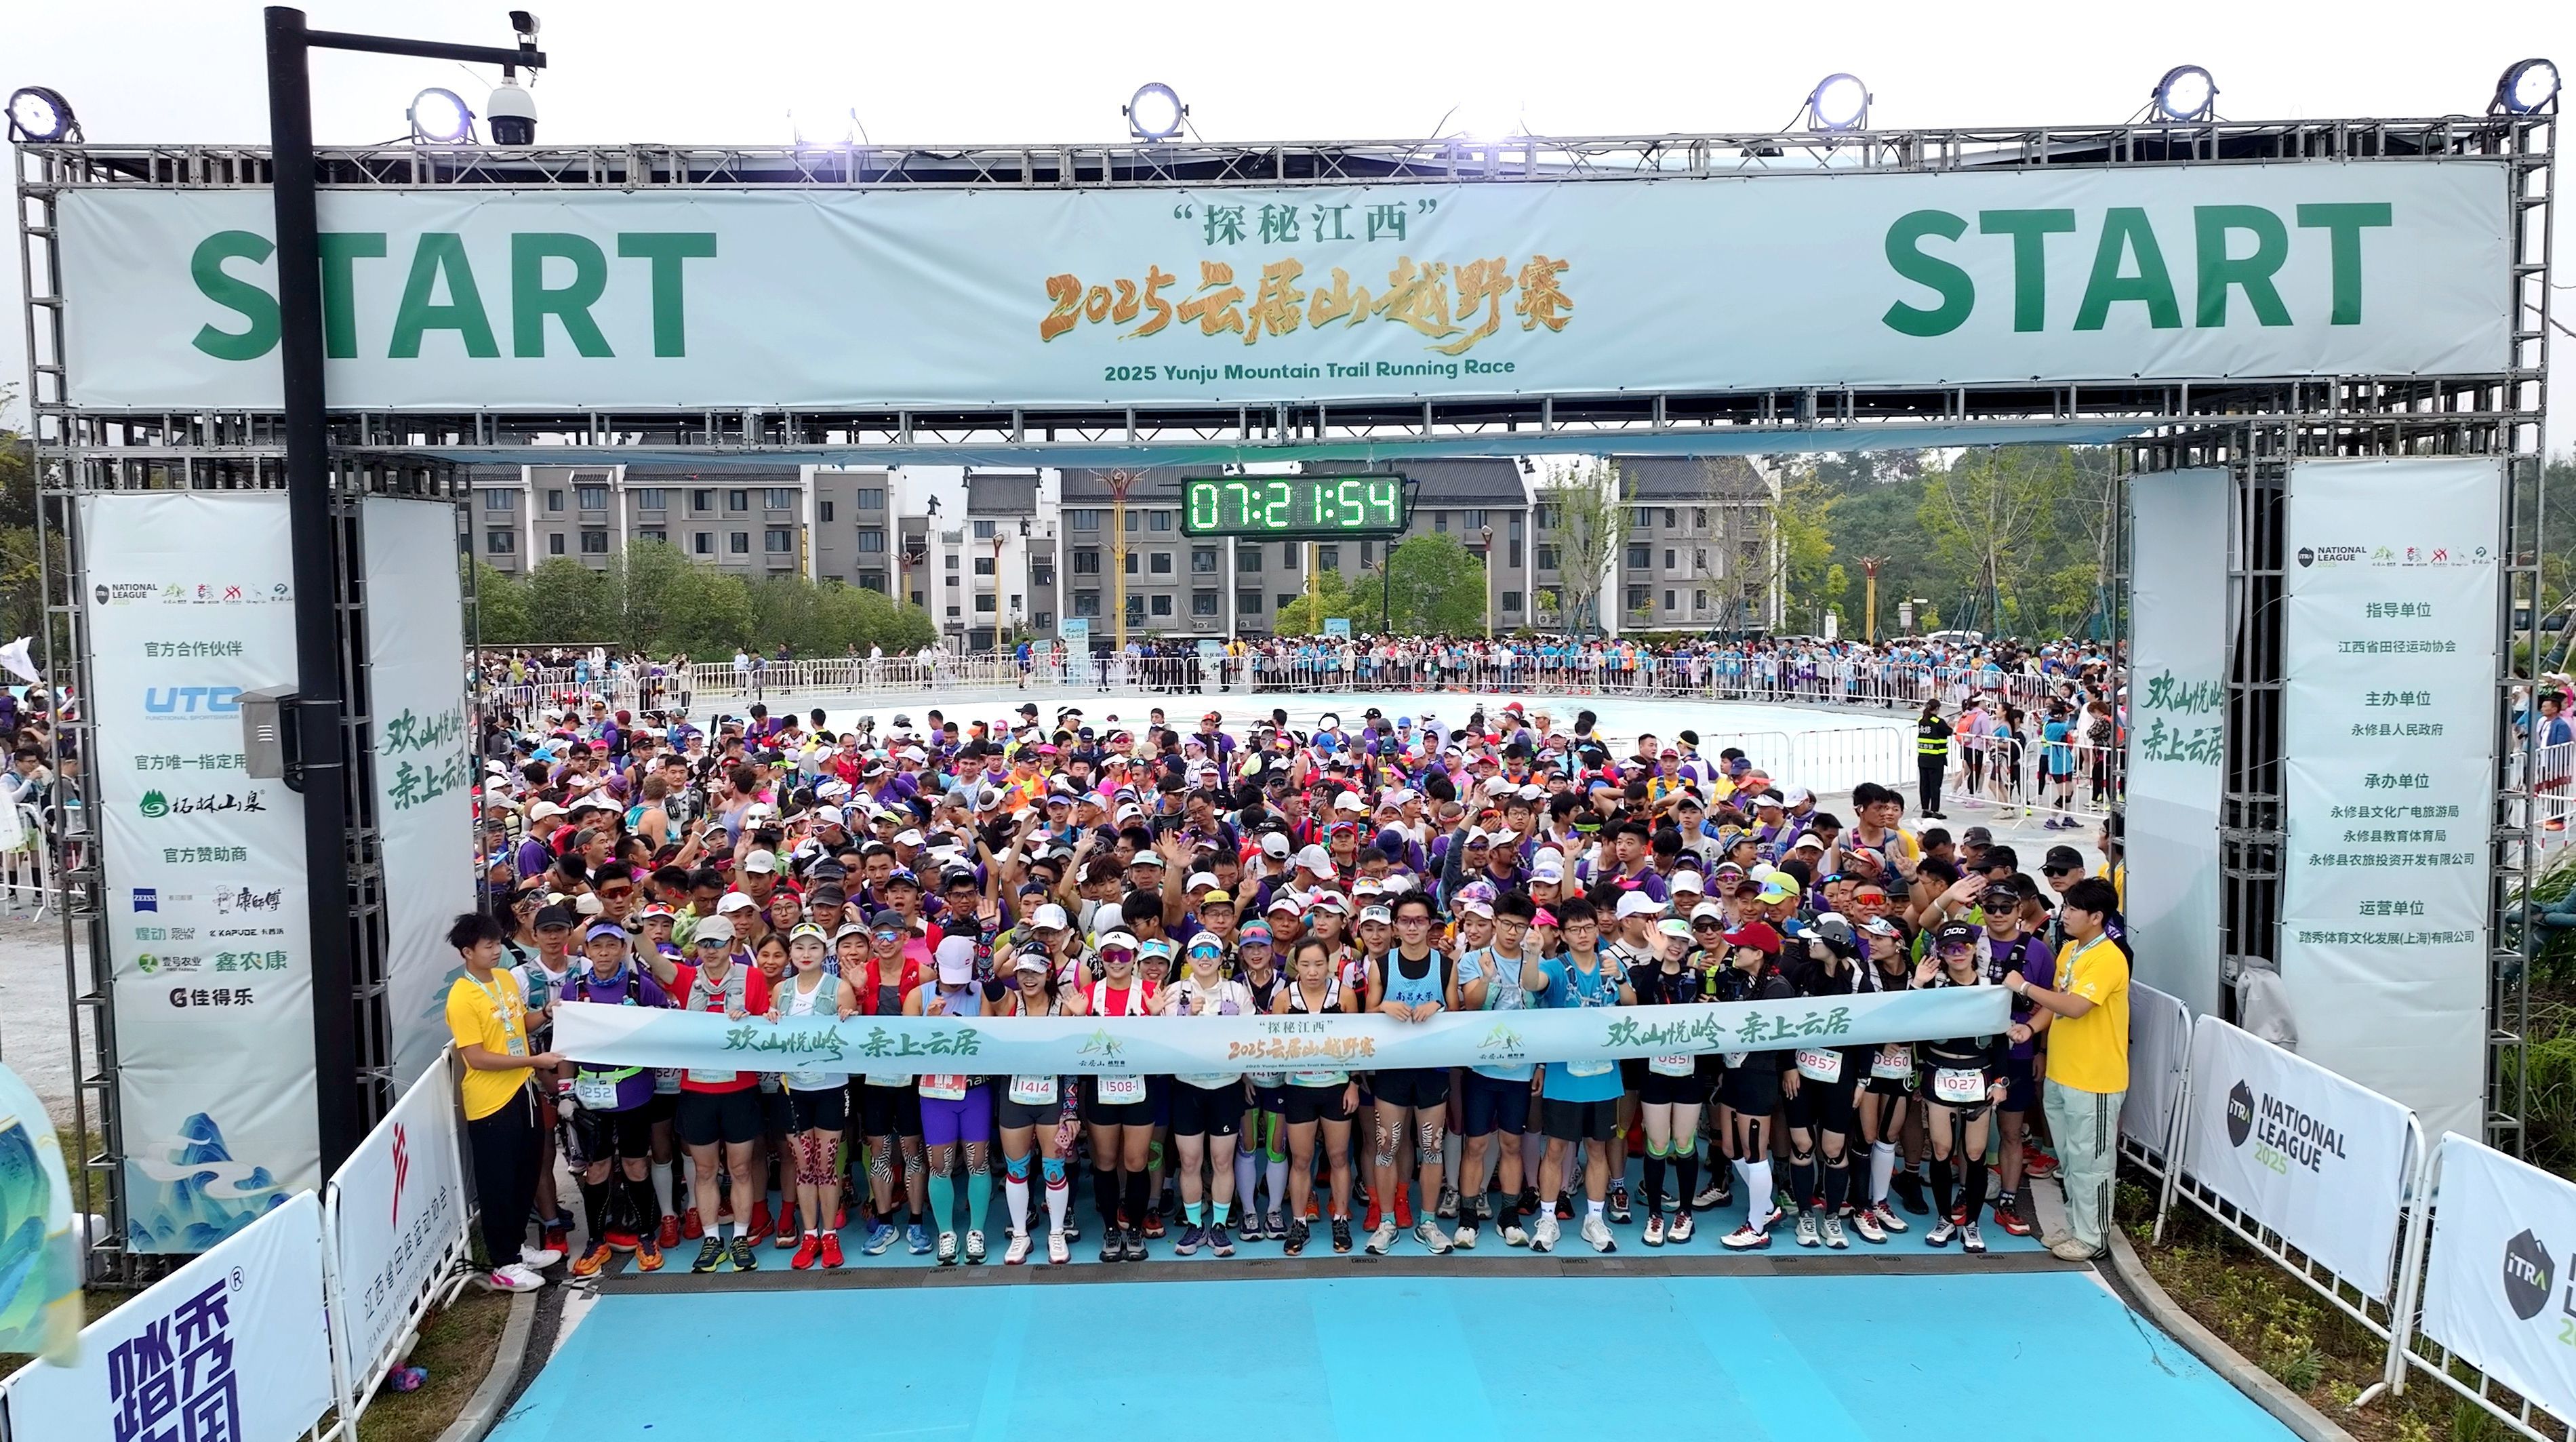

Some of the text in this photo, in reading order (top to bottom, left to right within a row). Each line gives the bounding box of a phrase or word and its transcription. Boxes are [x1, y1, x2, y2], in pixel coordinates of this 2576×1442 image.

[1882, 203, 2392, 336] START
[191, 230, 717, 361] START
[1104, 359, 1515, 384] 2025 Yunju Mountain Trail Running Race
[1192, 480, 1395, 529] 07:21:54
[2318, 546, 2367, 555] NATIONAL
[2366, 601, 2432, 618] 指导单位
[144, 640, 243, 658] 官方合作伙伴
[2338, 639, 2456, 654] 江西省田径运动协会
[2365, 690, 2431, 706] 主办单位
[2351, 723, 2443, 736] 永修县人民政府
[2364, 773, 2430, 789] 承办单位
[2331, 805, 2459, 818] 永修县文化广电旅游局
[2343, 829, 2447, 843] 永修县教育体育局
[163, 847, 247, 863] 官方赞助商
[2309, 852, 2474, 866] 永修县农旅投资开发有限公司
[2359, 900, 2424, 916] 运营单位
[216, 950, 287, 972] 鑫农康
[1799, 1052, 1836, 1070] 0857
[1020, 1081, 1049, 1093] 1414
[1106, 1079, 1139, 1092] 1508-1
[1944, 1077, 1977, 1089] 1027
[2261, 1093, 2346, 1160] NATIONAL
[2257, 1117, 2322, 1174] LEAGUE
[2254, 1142, 2288, 1176] 2025
